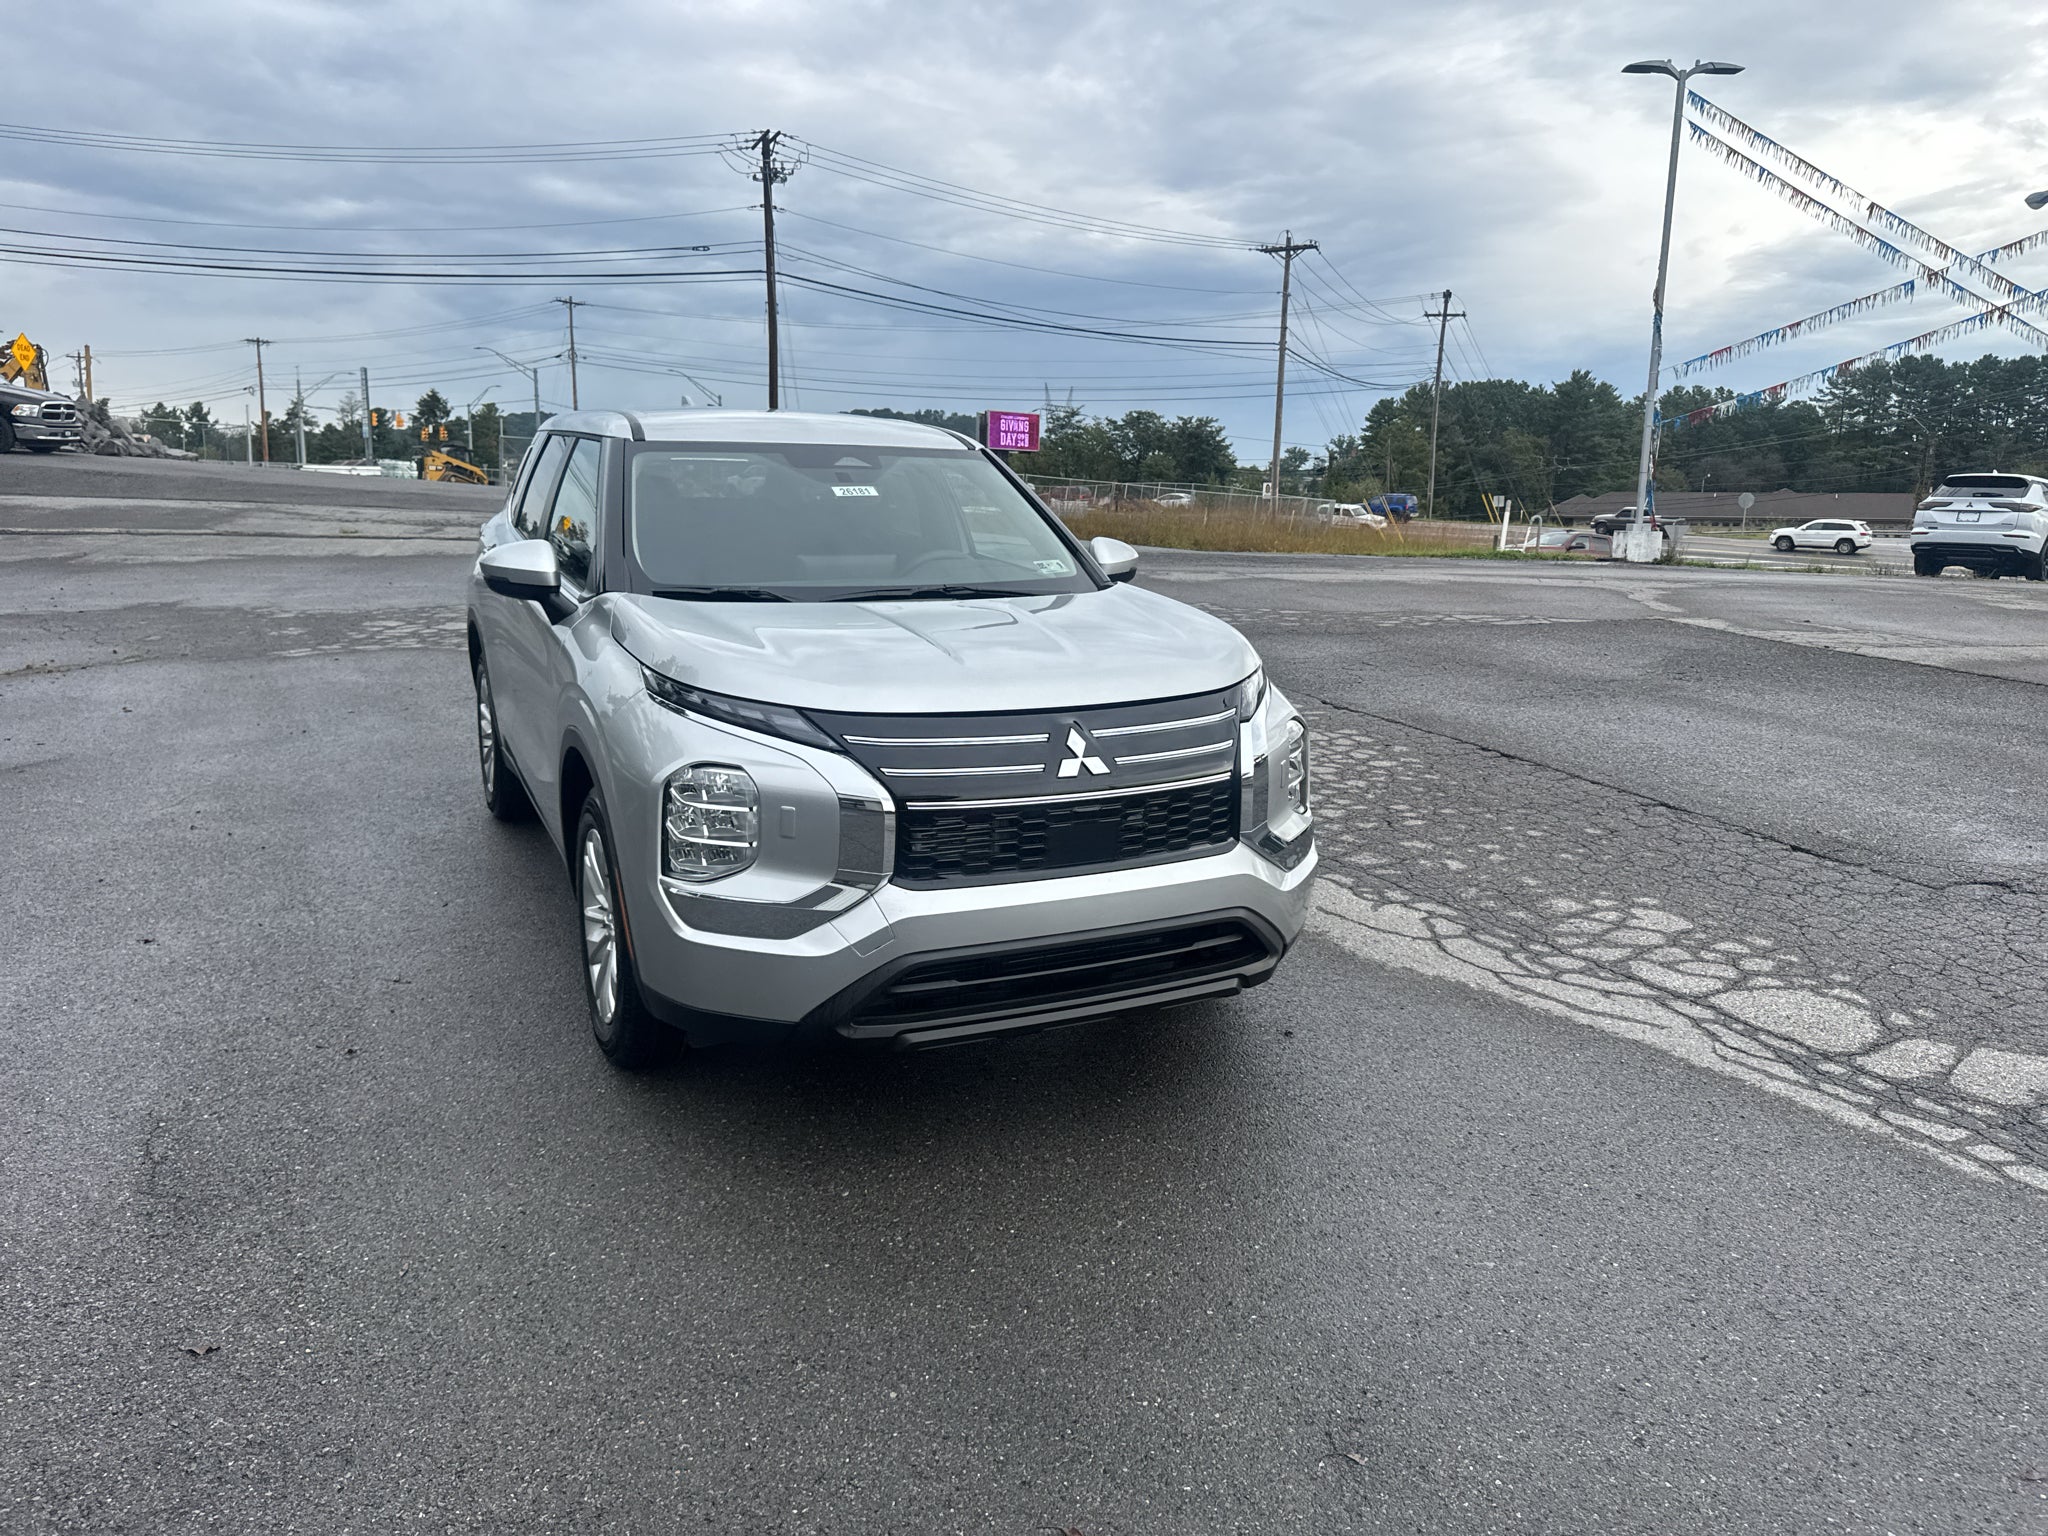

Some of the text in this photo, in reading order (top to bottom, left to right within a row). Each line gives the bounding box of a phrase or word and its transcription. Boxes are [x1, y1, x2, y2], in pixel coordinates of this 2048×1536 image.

[16, 344, 30, 352] DEAD
[20, 353, 30, 362] END
[1000, 431, 1017, 446] DAY
[839, 487, 871, 496] 26181
